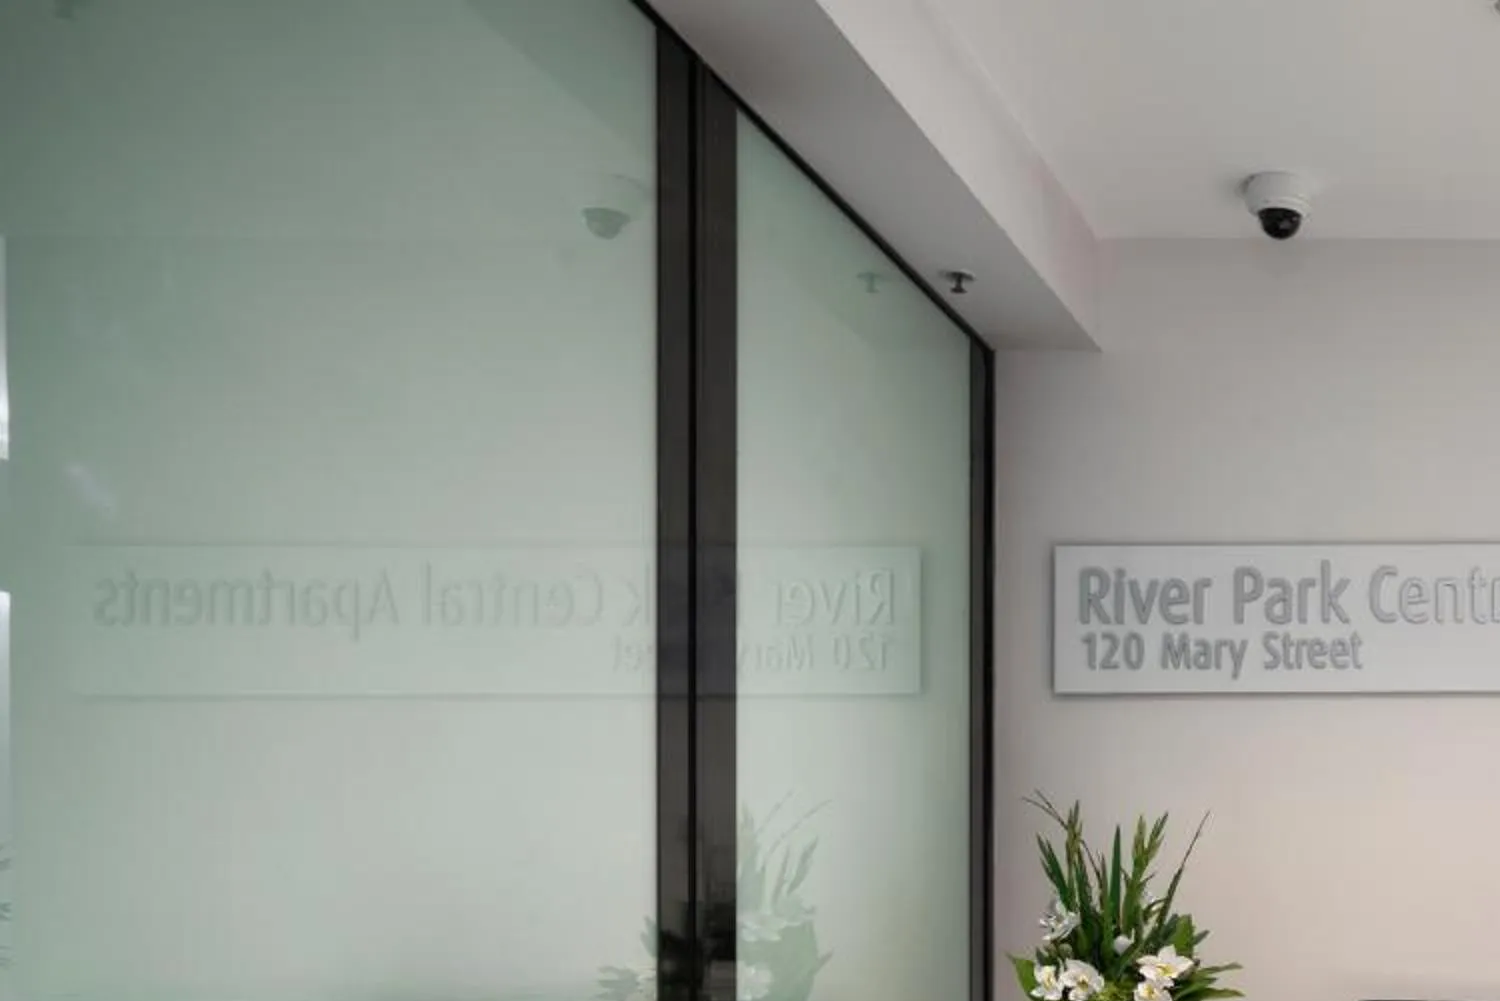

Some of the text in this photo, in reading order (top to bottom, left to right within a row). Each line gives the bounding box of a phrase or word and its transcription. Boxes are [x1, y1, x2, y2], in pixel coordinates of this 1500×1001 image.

[1078, 566, 1213, 625] River
[1232, 559, 1351, 625] Park
[1081, 630, 1363, 680] 120 Mary Street
